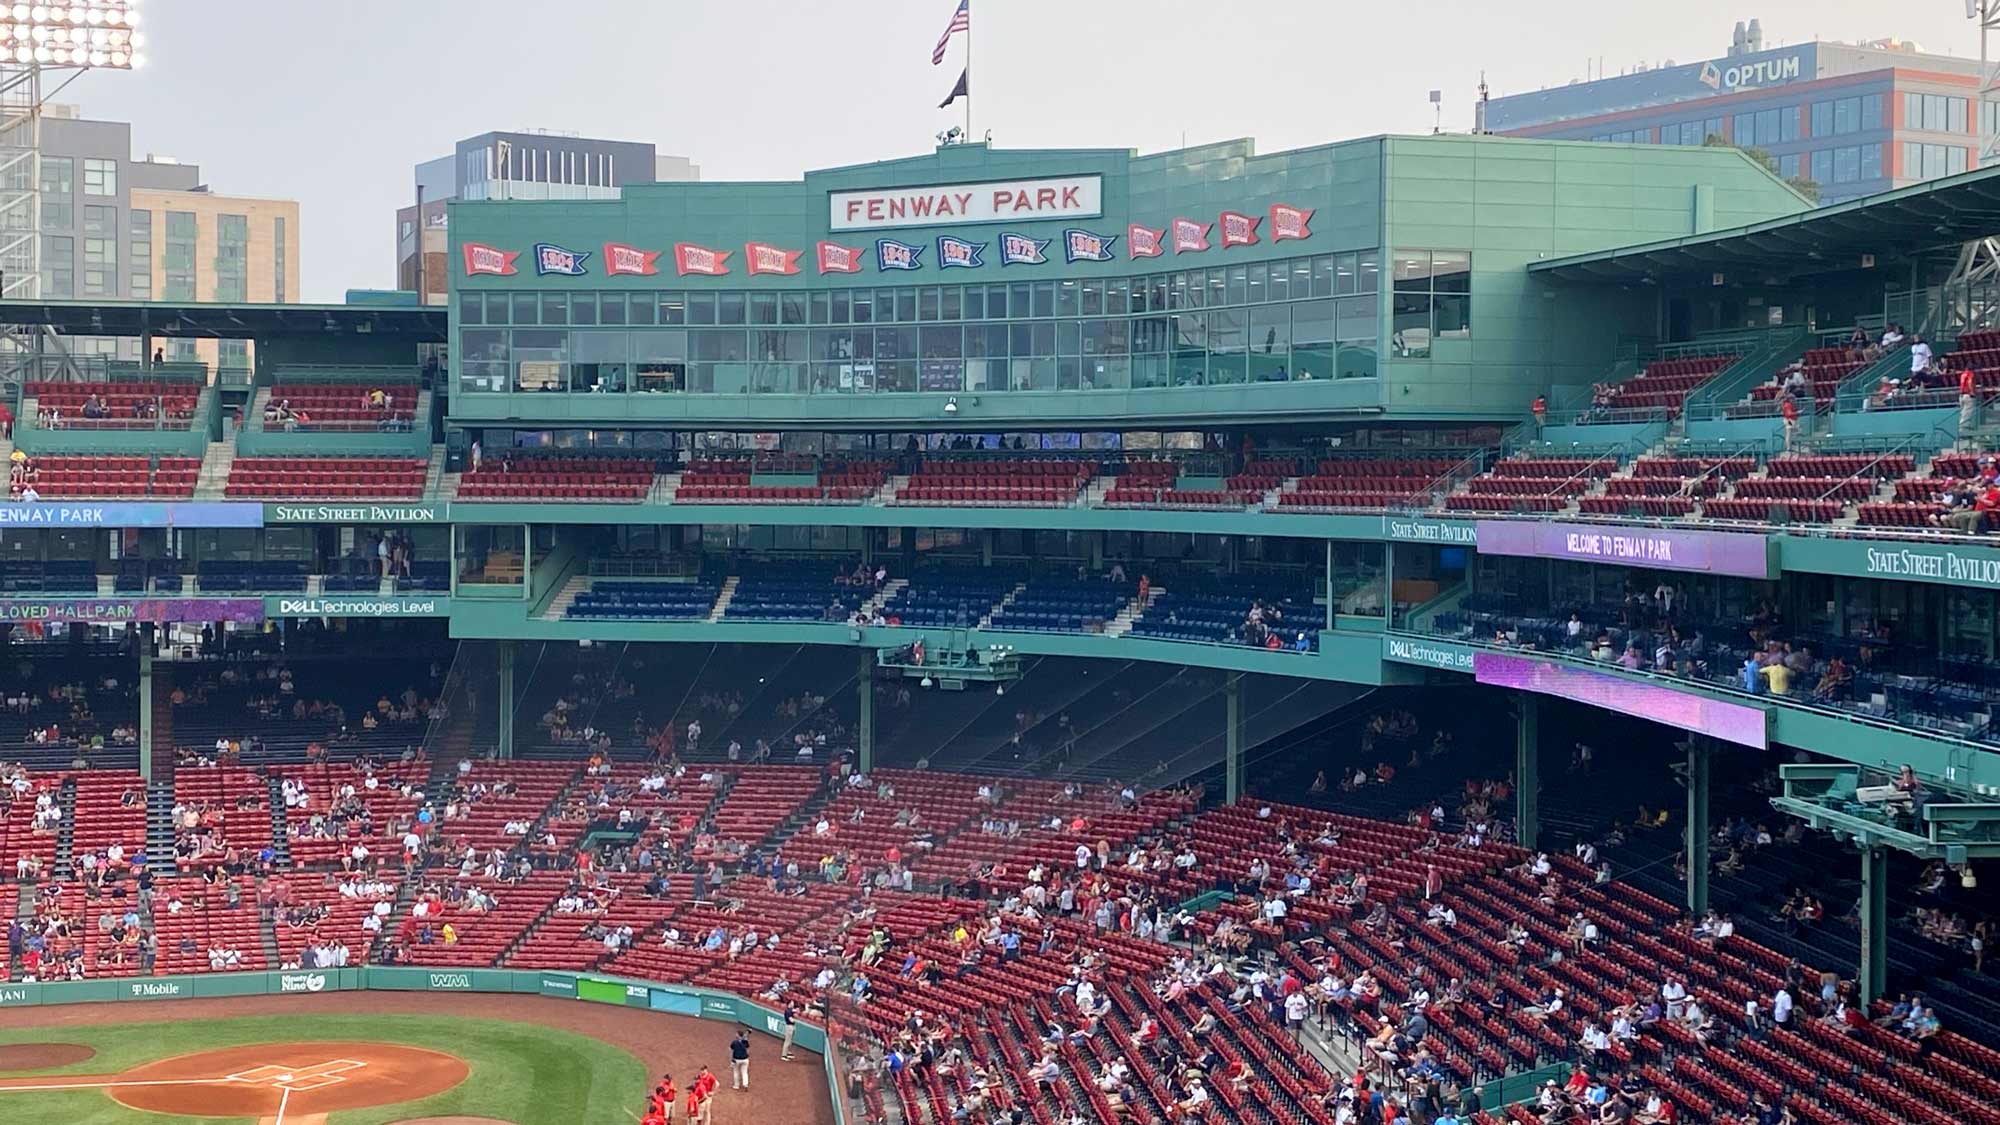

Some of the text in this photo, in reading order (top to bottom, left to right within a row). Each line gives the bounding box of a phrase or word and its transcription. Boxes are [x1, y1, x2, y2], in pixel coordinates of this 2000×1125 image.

[1724, 56, 1800, 87] OPTUM
[846, 185, 1081, 221] FENWAY PARK
[1006, 239, 1036, 257] 1975
[0, 508, 103, 522] ENWAY PARK
[276, 506, 434, 520] STATE STREET PAVILION
[1391, 521, 1477, 542] STATE STREET PAVILION
[1567, 533, 1672, 560] WELCOME TO FENWAY PARK
[1867, 547, 1900, 573] STATE
[1901, 549, 1944, 577] STREET
[280, 600, 434, 616] DELL Technologies Level
[1390, 640, 1474, 668] DELL Technologies Level
[143, 983, 179, 995] Mobile
[430, 974, 470, 988] WM
